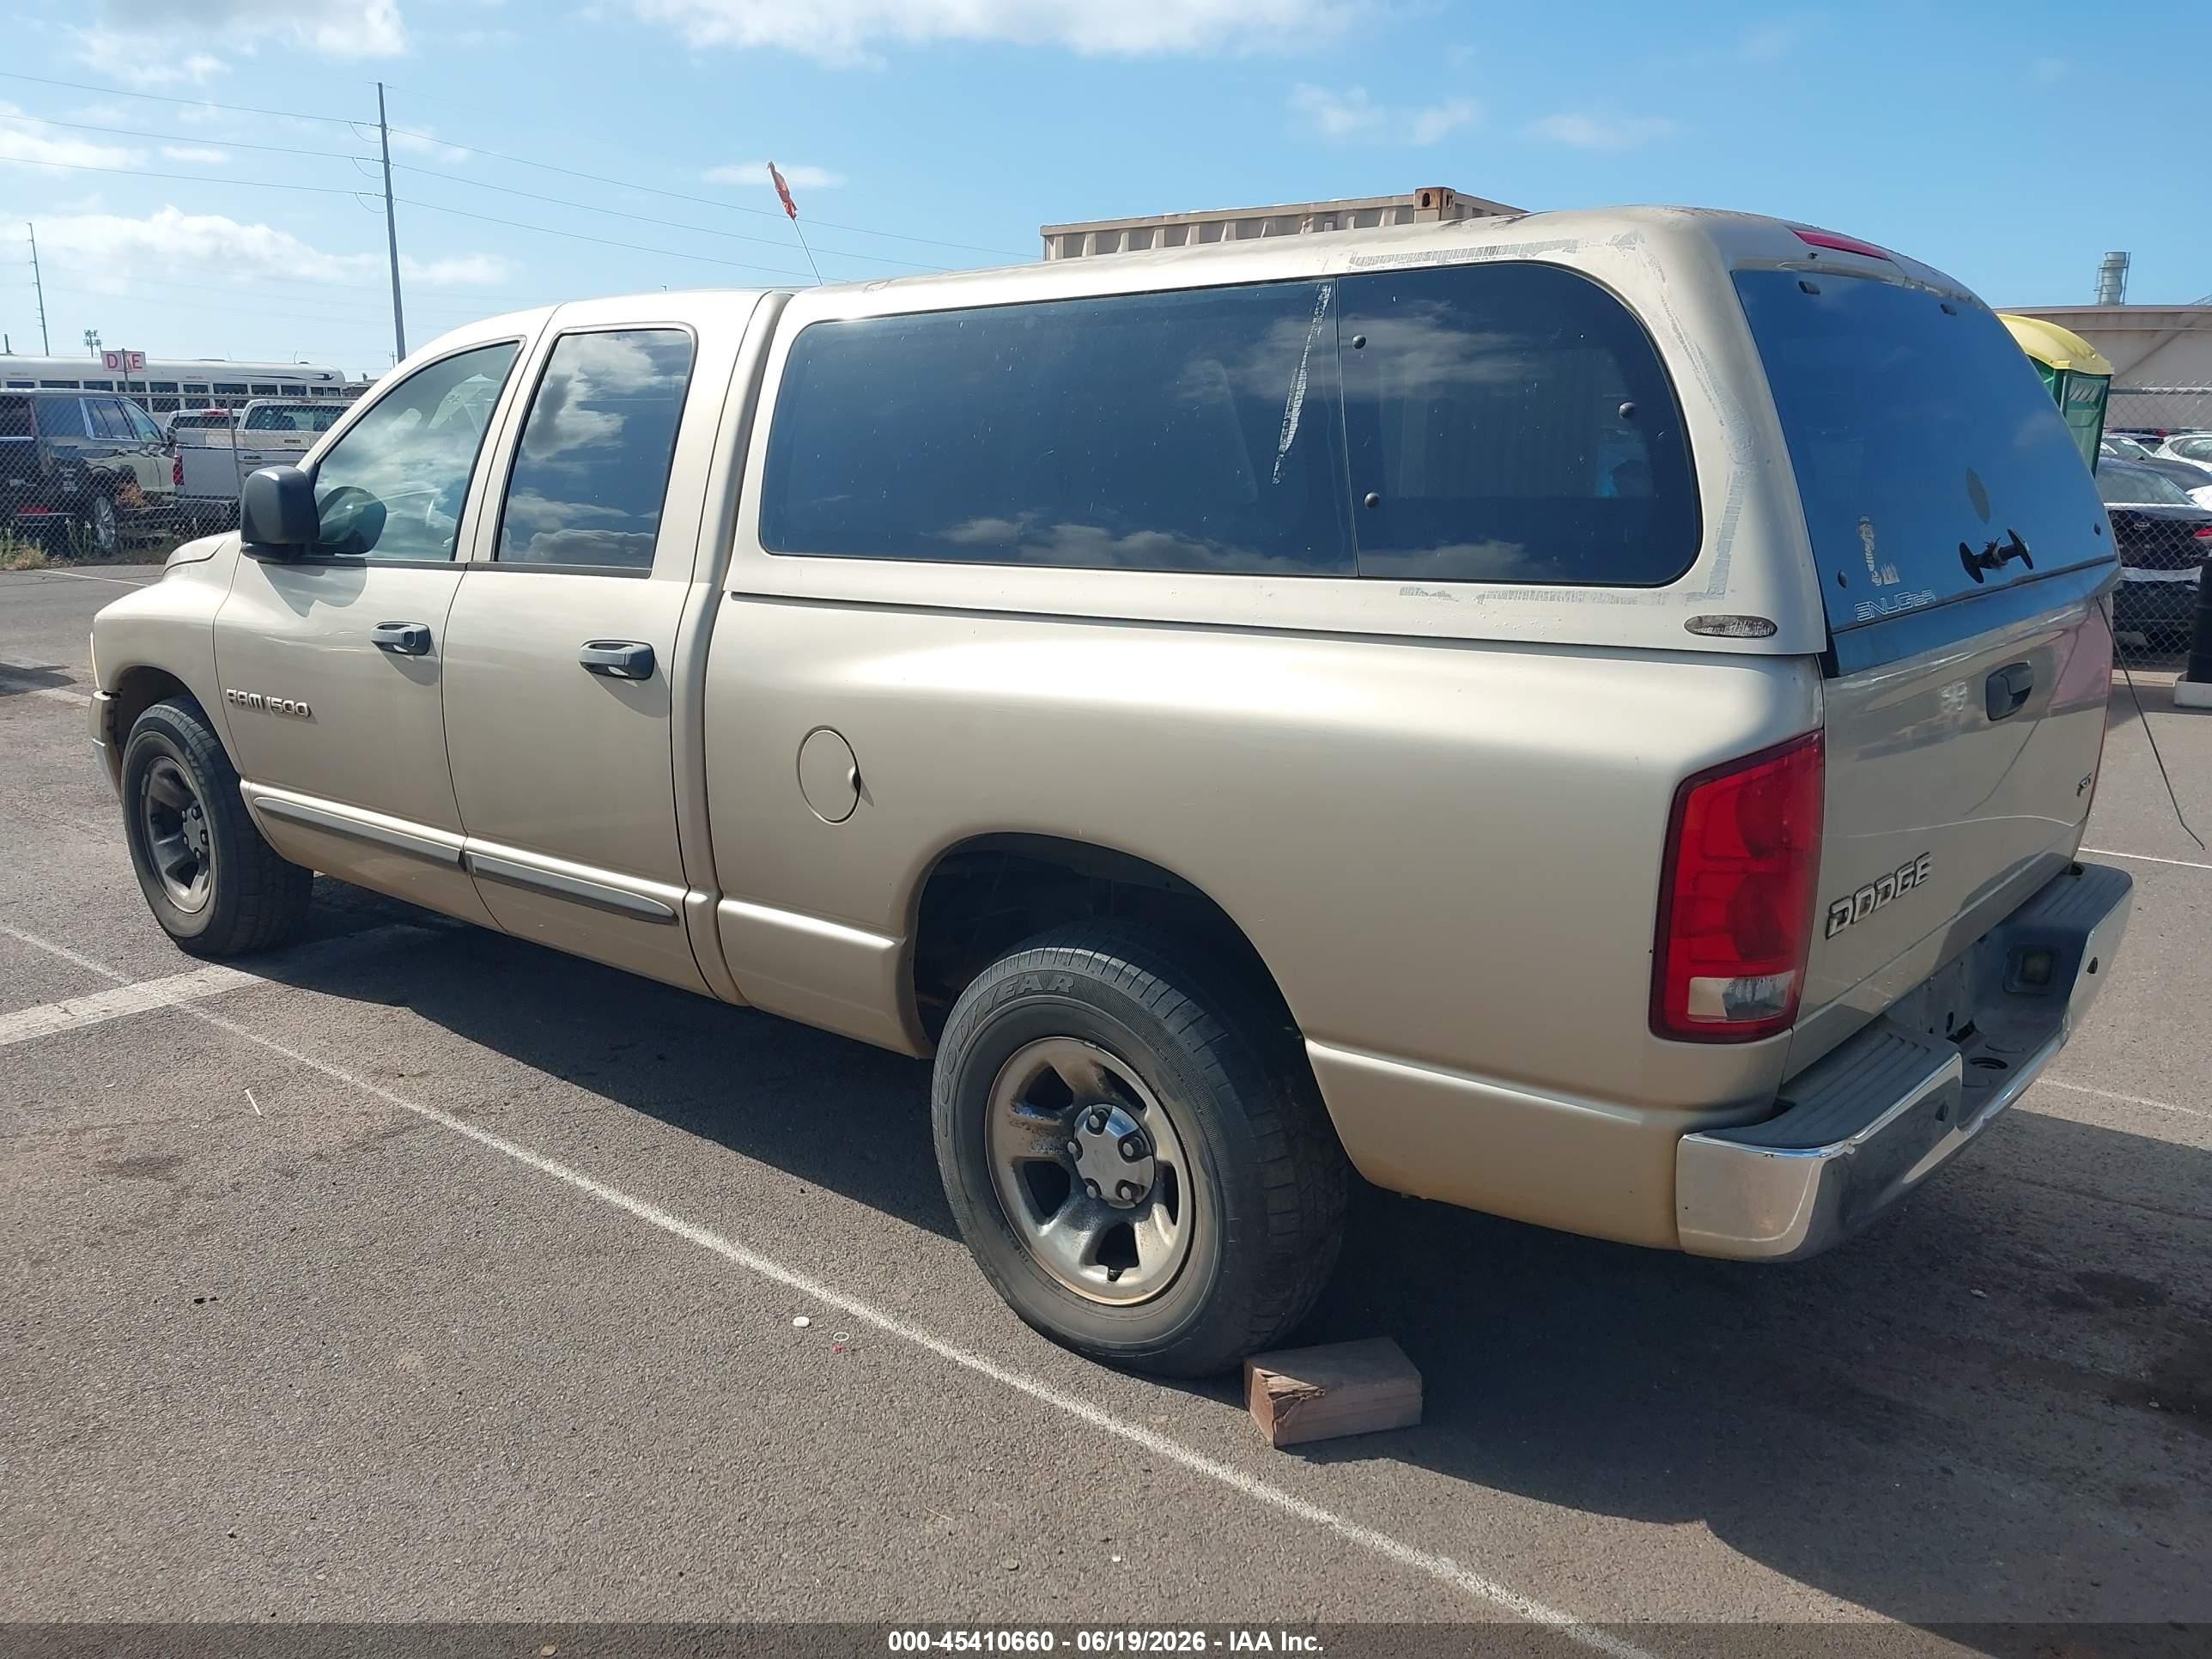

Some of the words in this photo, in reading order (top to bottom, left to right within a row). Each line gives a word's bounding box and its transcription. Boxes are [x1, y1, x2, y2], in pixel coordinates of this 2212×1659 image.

[226, 688, 265, 711] RAM
[265, 696, 312, 718] 1500
[1826, 851, 1933, 939] DODGE
